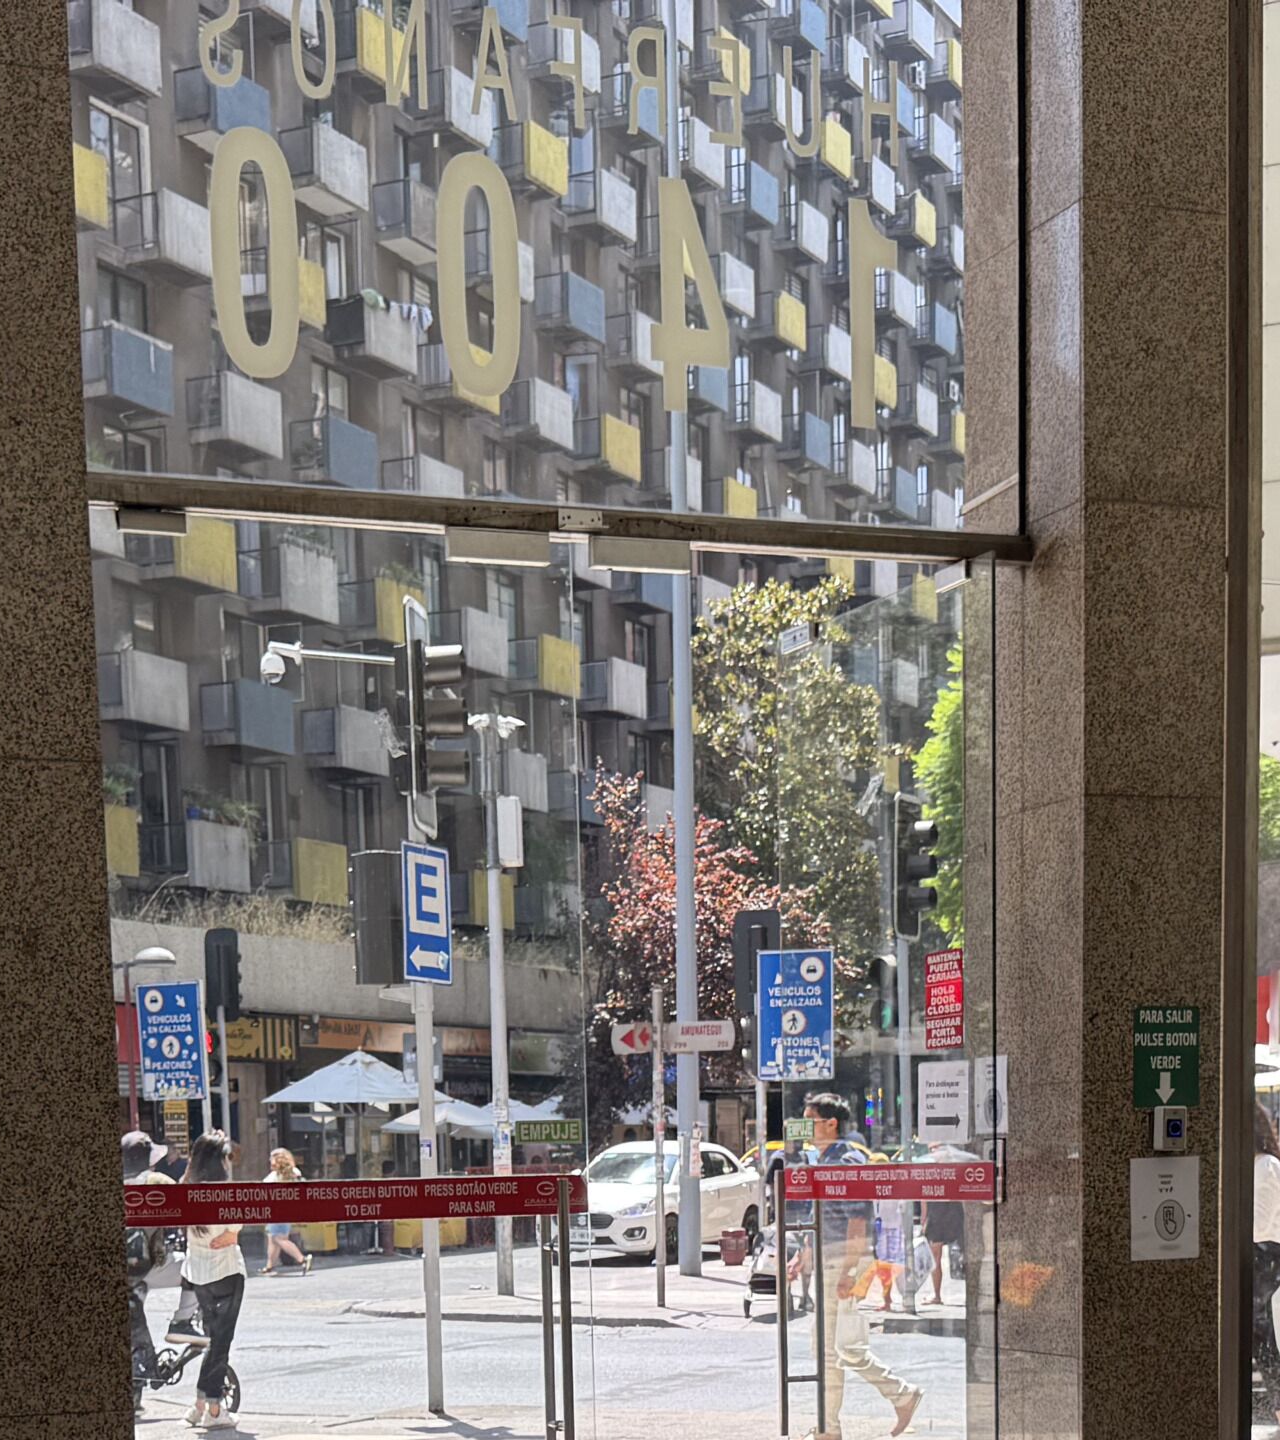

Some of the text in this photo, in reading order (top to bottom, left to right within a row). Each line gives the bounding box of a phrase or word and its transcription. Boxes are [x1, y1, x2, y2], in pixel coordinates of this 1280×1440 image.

[929, 961, 959, 973] PUERTA
[931, 985, 955, 996] HOLD
[930, 995, 956, 1006] DOOR
[927, 1003, 962, 1015] CLOSED
[147, 1013, 192, 1024] VEHICULOS
[1140, 1010, 1193, 1024] PARA SALIR
[147, 1024, 192, 1034] EN CALZADA
[927, 1036, 962, 1047] FECHADO
[1134, 1033, 1197, 1046] PULSE BOTON
[1150, 1056, 1181, 1069] VERDE
[520, 1123, 579, 1140] EMPUJE
[964, 1167, 985, 1182] GS
[187, 1188, 300, 1203] PRESIONE BOTON VERDE
[306, 1185, 418, 1199] PRESS GREEN BUTTON
[424, 1181, 519, 1197] PRESS BOTÃO VERDE
[219, 1207, 271, 1220] PARA SALIR
[344, 1204, 382, 1216] TO EXIT
[449, 1200, 496, 1214] PARA SAIR
